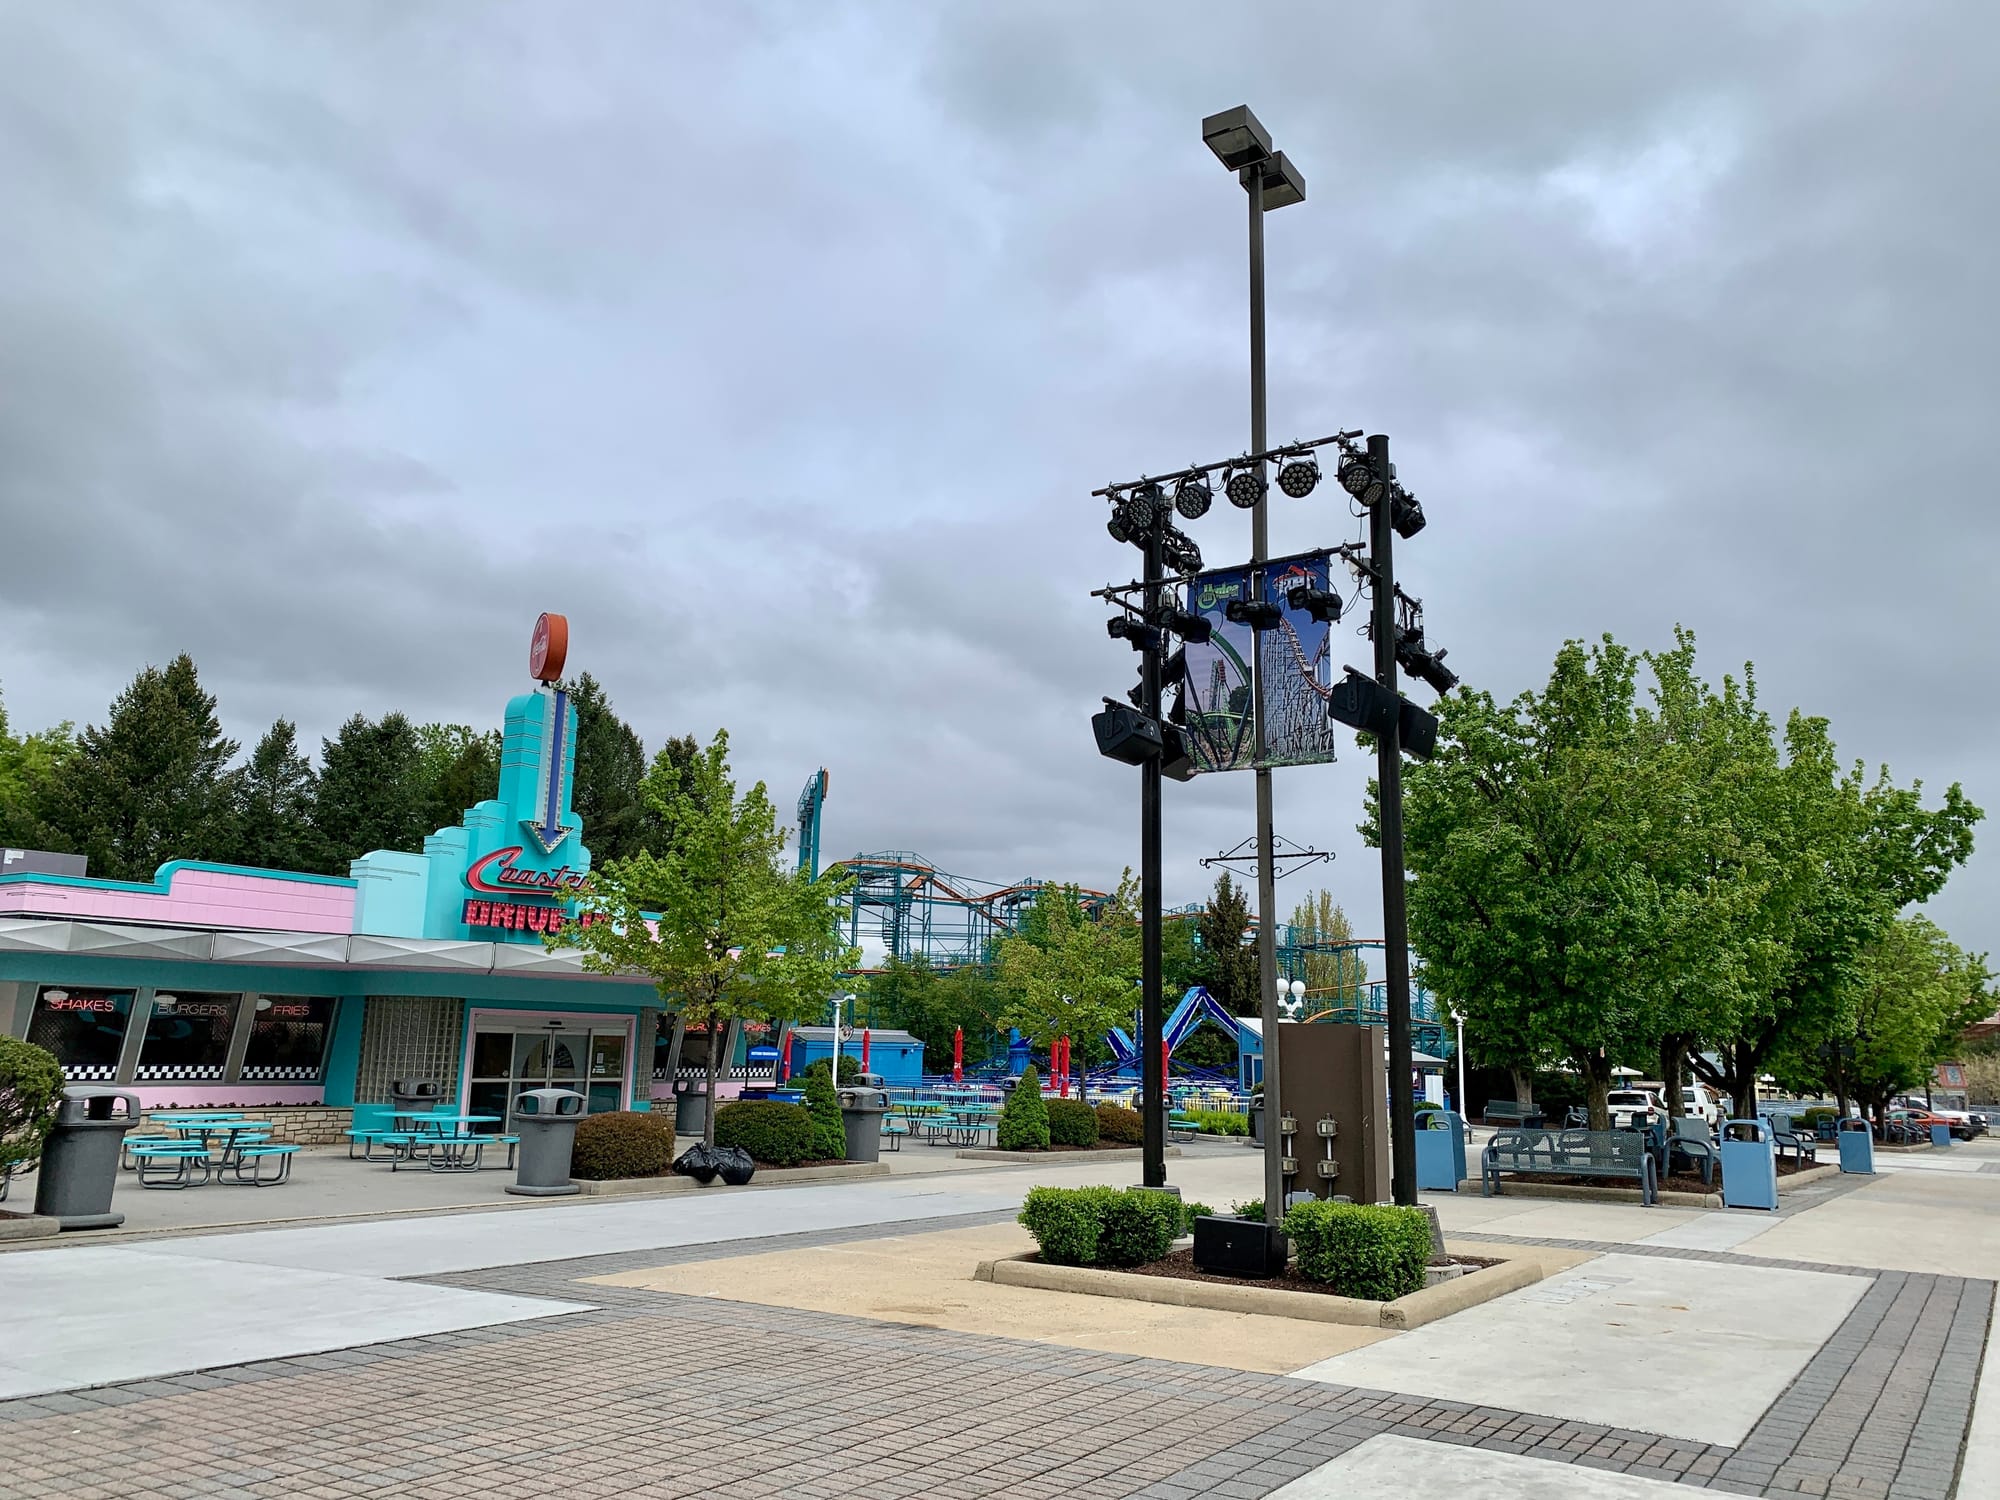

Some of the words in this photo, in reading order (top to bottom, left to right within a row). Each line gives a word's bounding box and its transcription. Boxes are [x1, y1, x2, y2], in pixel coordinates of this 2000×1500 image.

[50, 999, 115, 1013] SHAKES
[157, 1003, 229, 1016] BURGERS
[272, 1005, 311, 1017] FRIES
